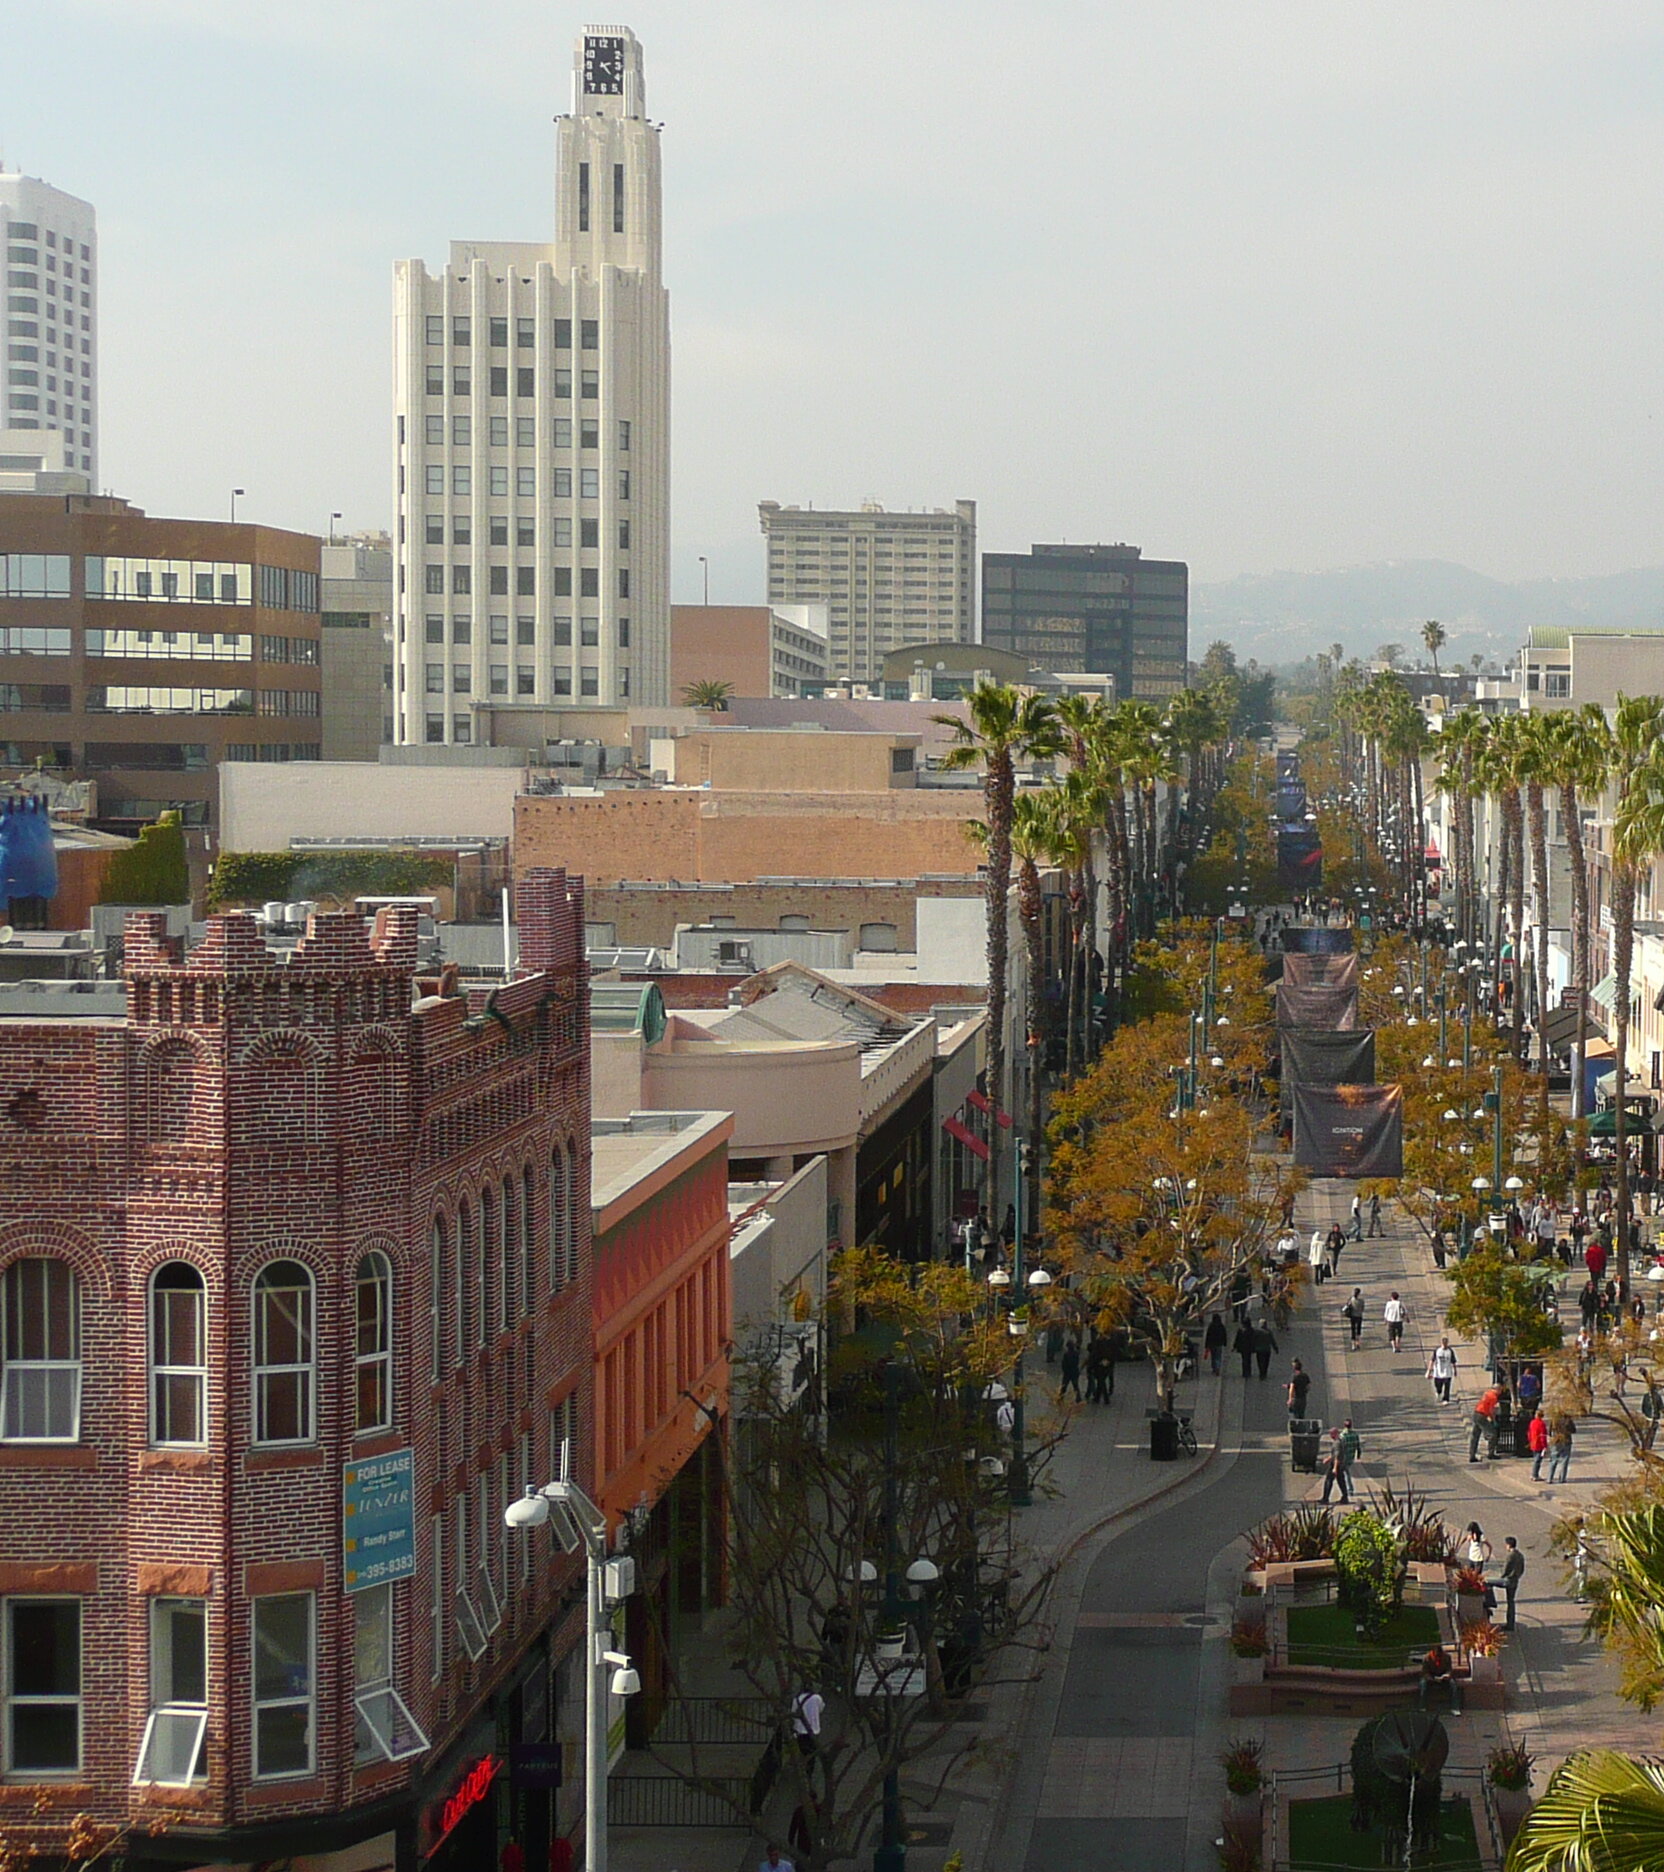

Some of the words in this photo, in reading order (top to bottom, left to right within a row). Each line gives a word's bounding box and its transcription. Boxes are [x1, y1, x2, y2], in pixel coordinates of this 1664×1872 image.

[590, 38, 596, 48] 11
[599, 38, 608, 48] 12
[586, 49, 595, 58] 10
[614, 50, 621, 60] 2
[586, 60, 593, 70] 9
[614, 61, 621, 71] 3
[586, 72, 593, 80] 8
[614, 73, 620, 81] 4
[590, 82, 596, 92] 7
[600, 82, 607, 92] 6
[612, 83, 618, 92] 5
[357, 1465, 377, 1482] FOR
[380, 1457, 411, 1476] LEASE
[363, 1534, 387, 1547] Randy
